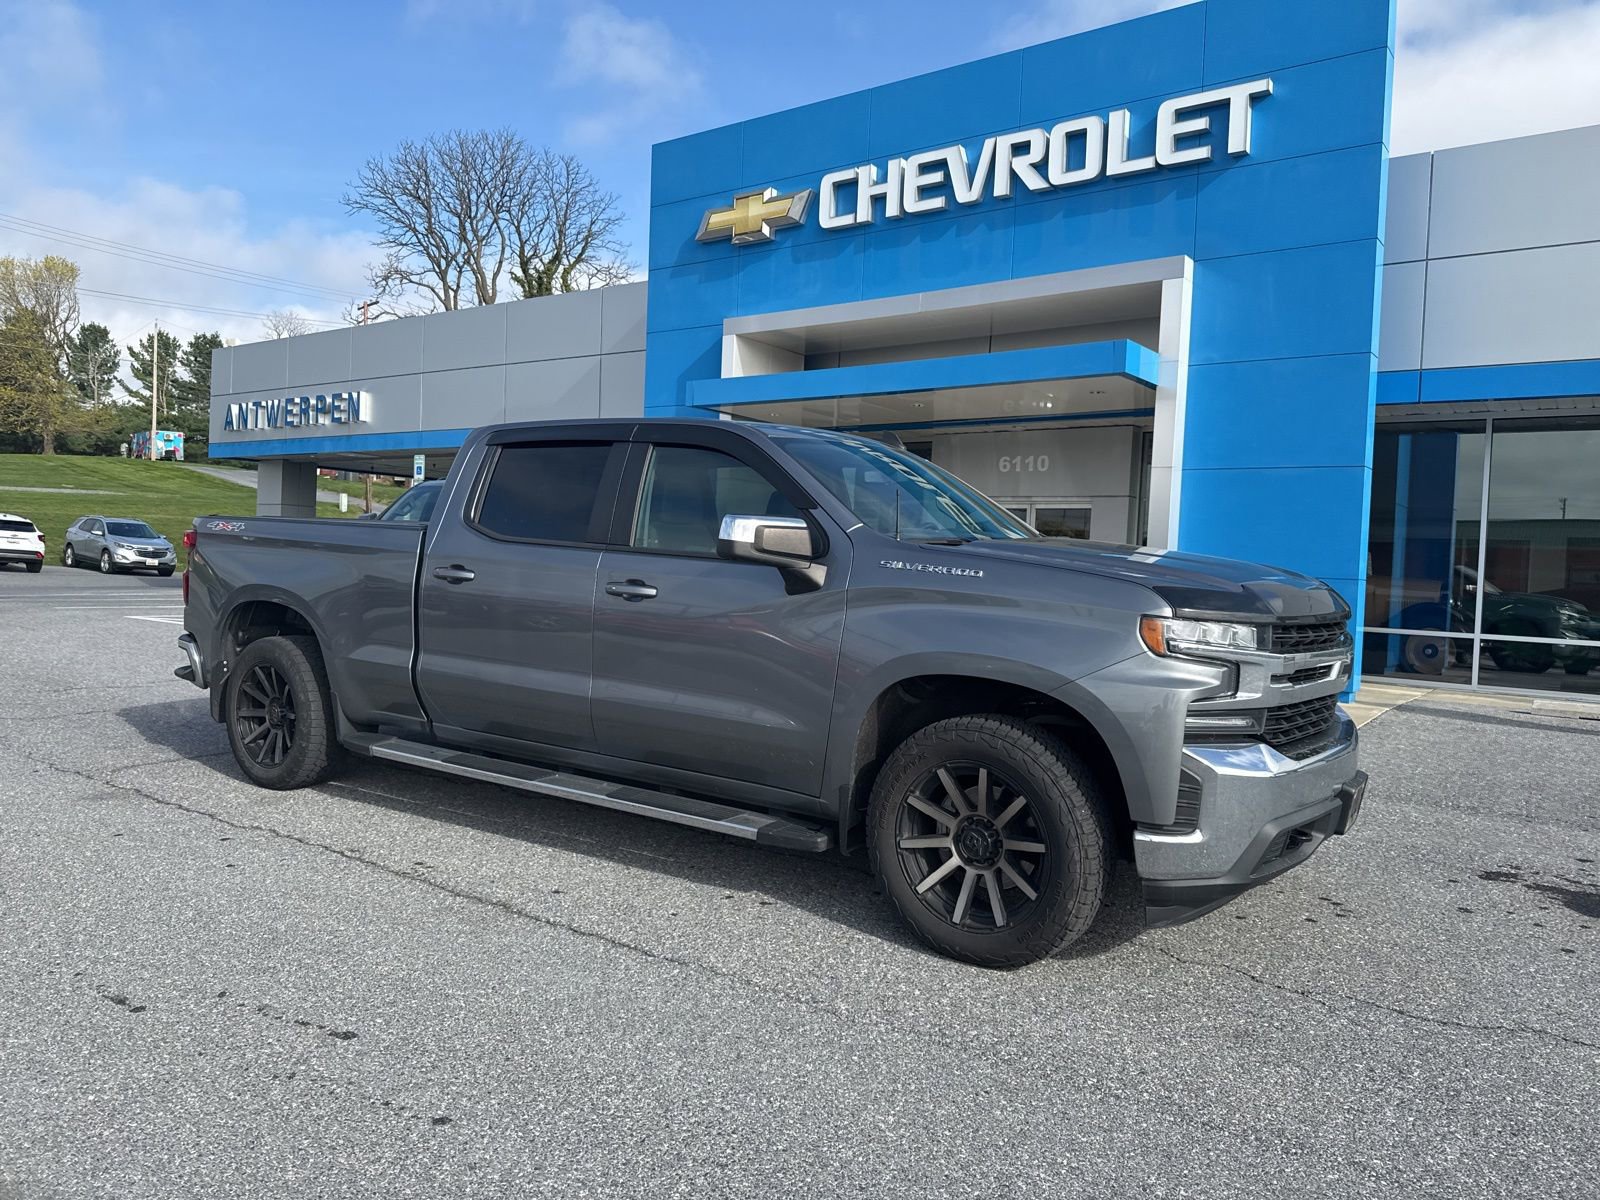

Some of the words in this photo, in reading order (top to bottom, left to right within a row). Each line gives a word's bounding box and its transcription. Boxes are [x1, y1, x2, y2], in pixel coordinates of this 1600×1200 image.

[818, 77, 1273, 230] CHEVROLET
[223, 391, 369, 431] ANTWERPEN
[998, 455, 1050, 473] 6110
[879, 560, 984, 578] SILVERADO
